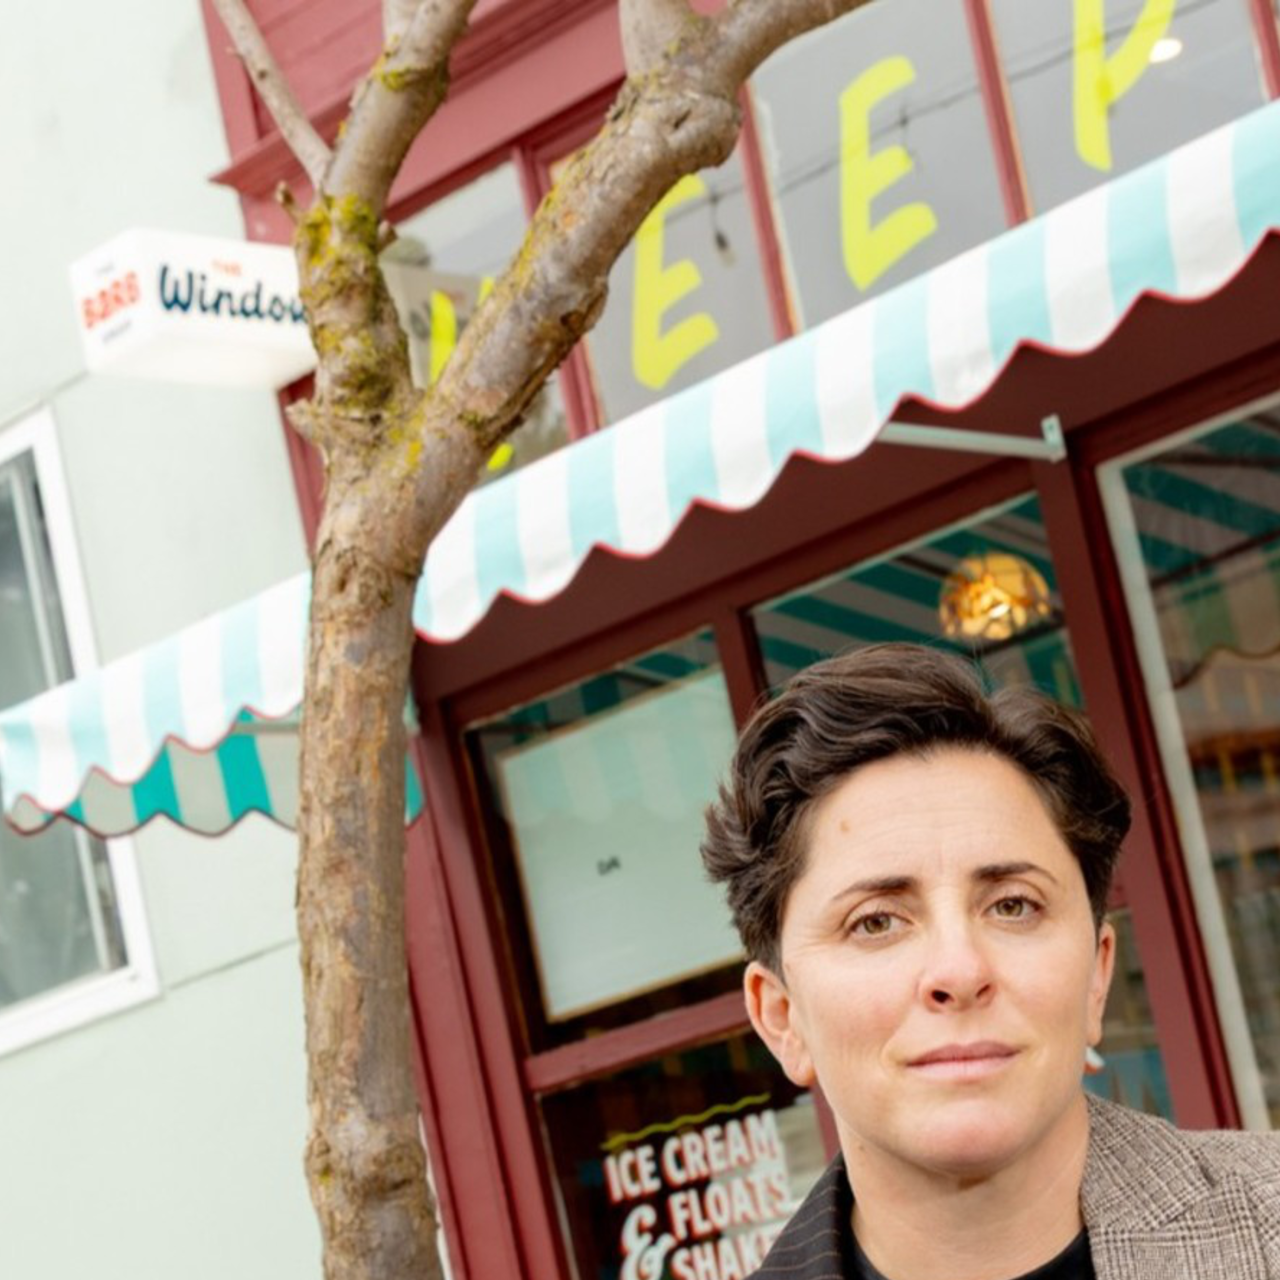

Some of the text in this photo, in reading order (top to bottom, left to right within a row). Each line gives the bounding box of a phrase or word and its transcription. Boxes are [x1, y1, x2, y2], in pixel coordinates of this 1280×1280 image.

[604, 1109, 784, 1204] ICE CREAM
[668, 1168, 799, 1242] FLOATS
